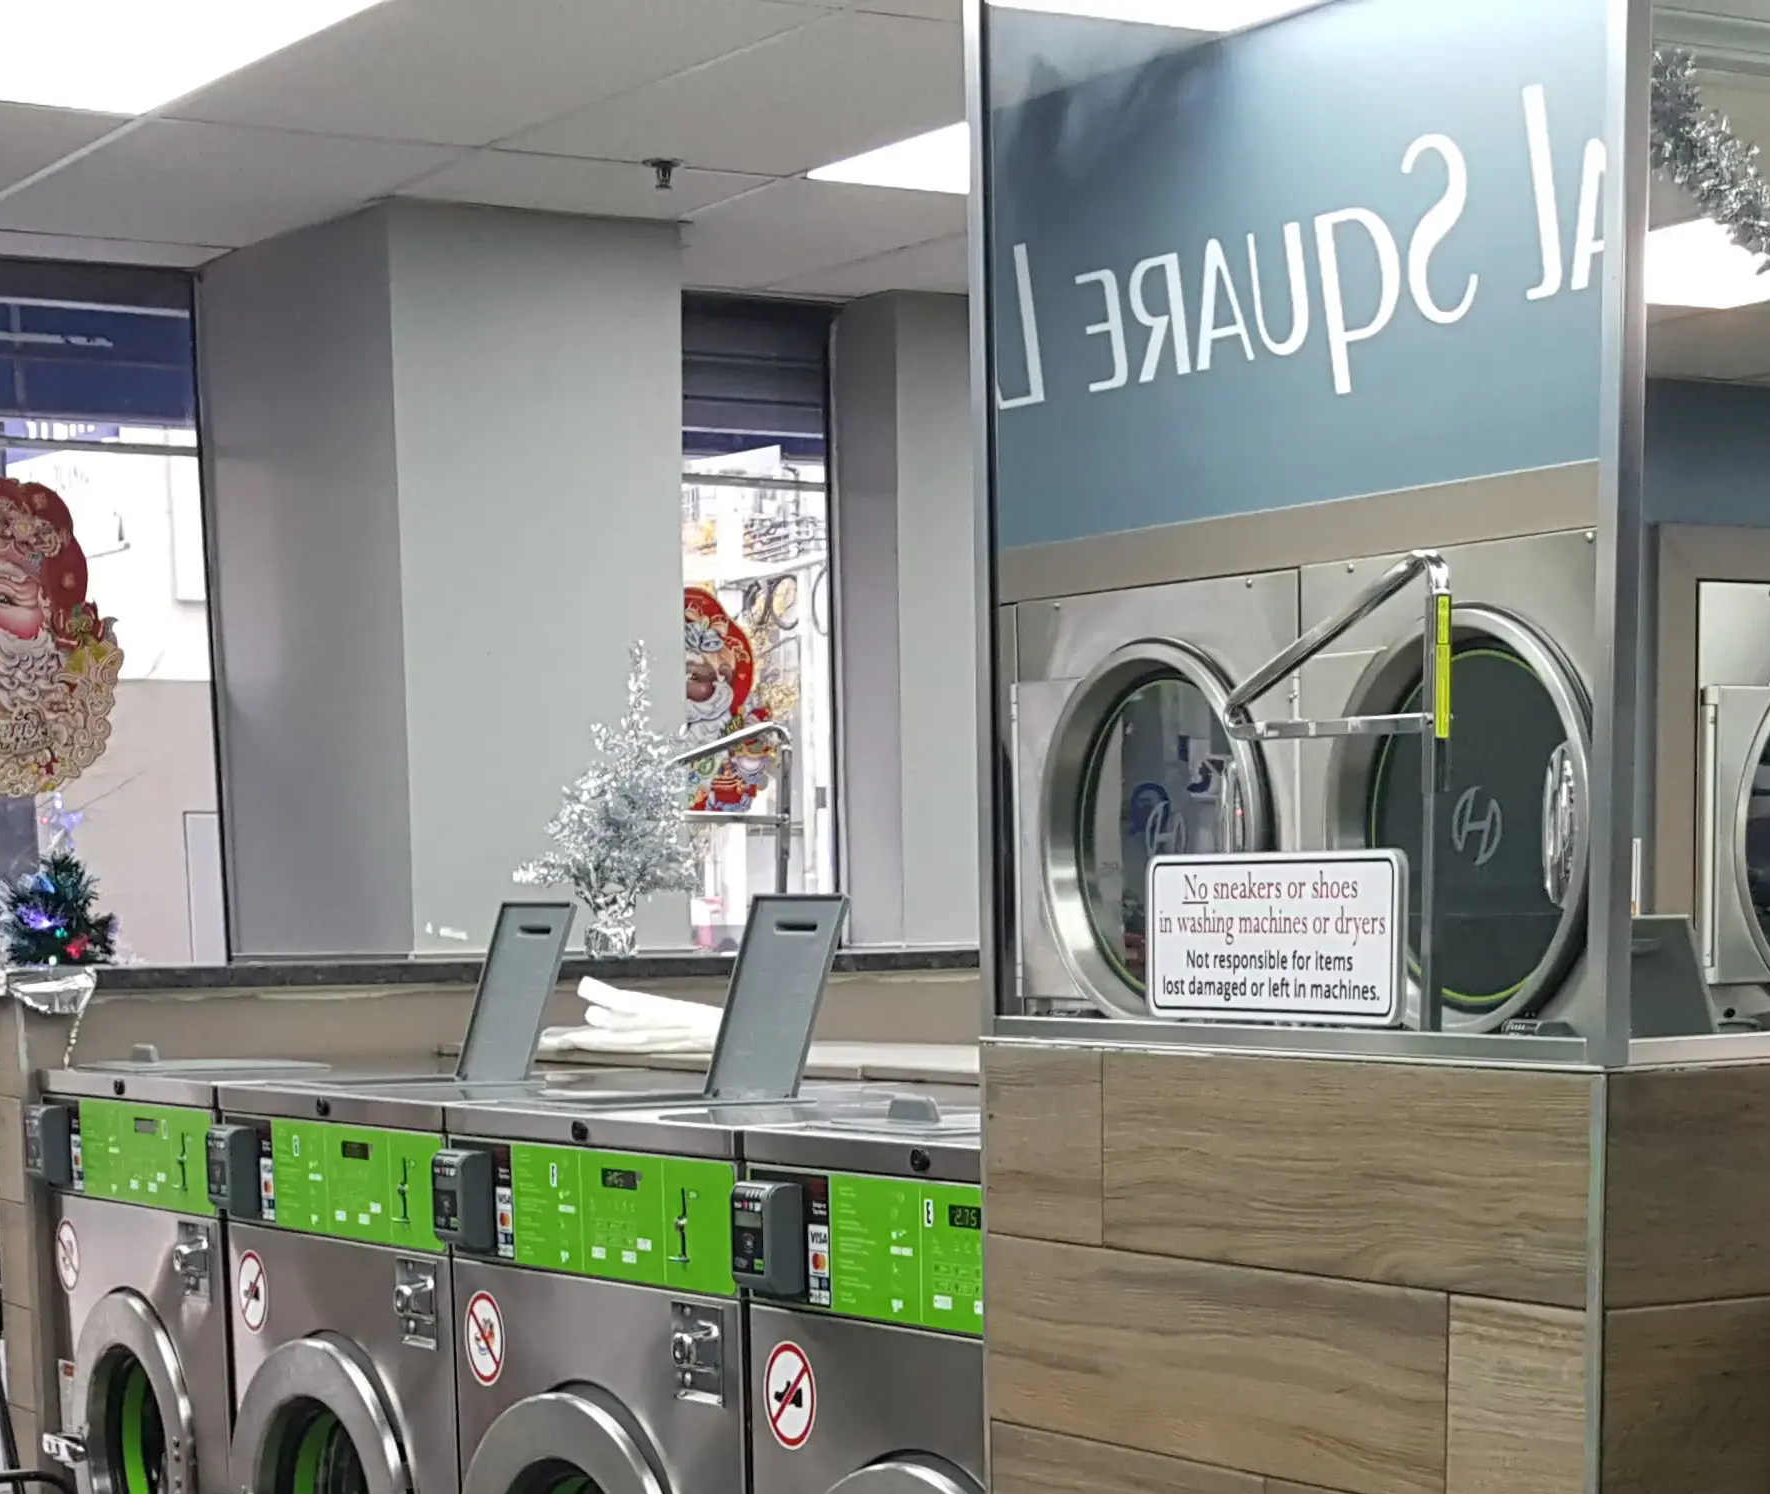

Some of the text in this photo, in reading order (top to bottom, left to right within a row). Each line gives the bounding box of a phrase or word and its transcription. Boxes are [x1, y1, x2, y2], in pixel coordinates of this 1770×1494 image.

[1183, 870, 1358, 903] No sneakers or shoes
[1159, 906, 1386, 946] in washing machines or dryers
[1186, 950, 1353, 974] Not responsible for items
[1163, 976, 1380, 1002] lost damaged or left in machines.
[810, 1231, 828, 1246] VISA
